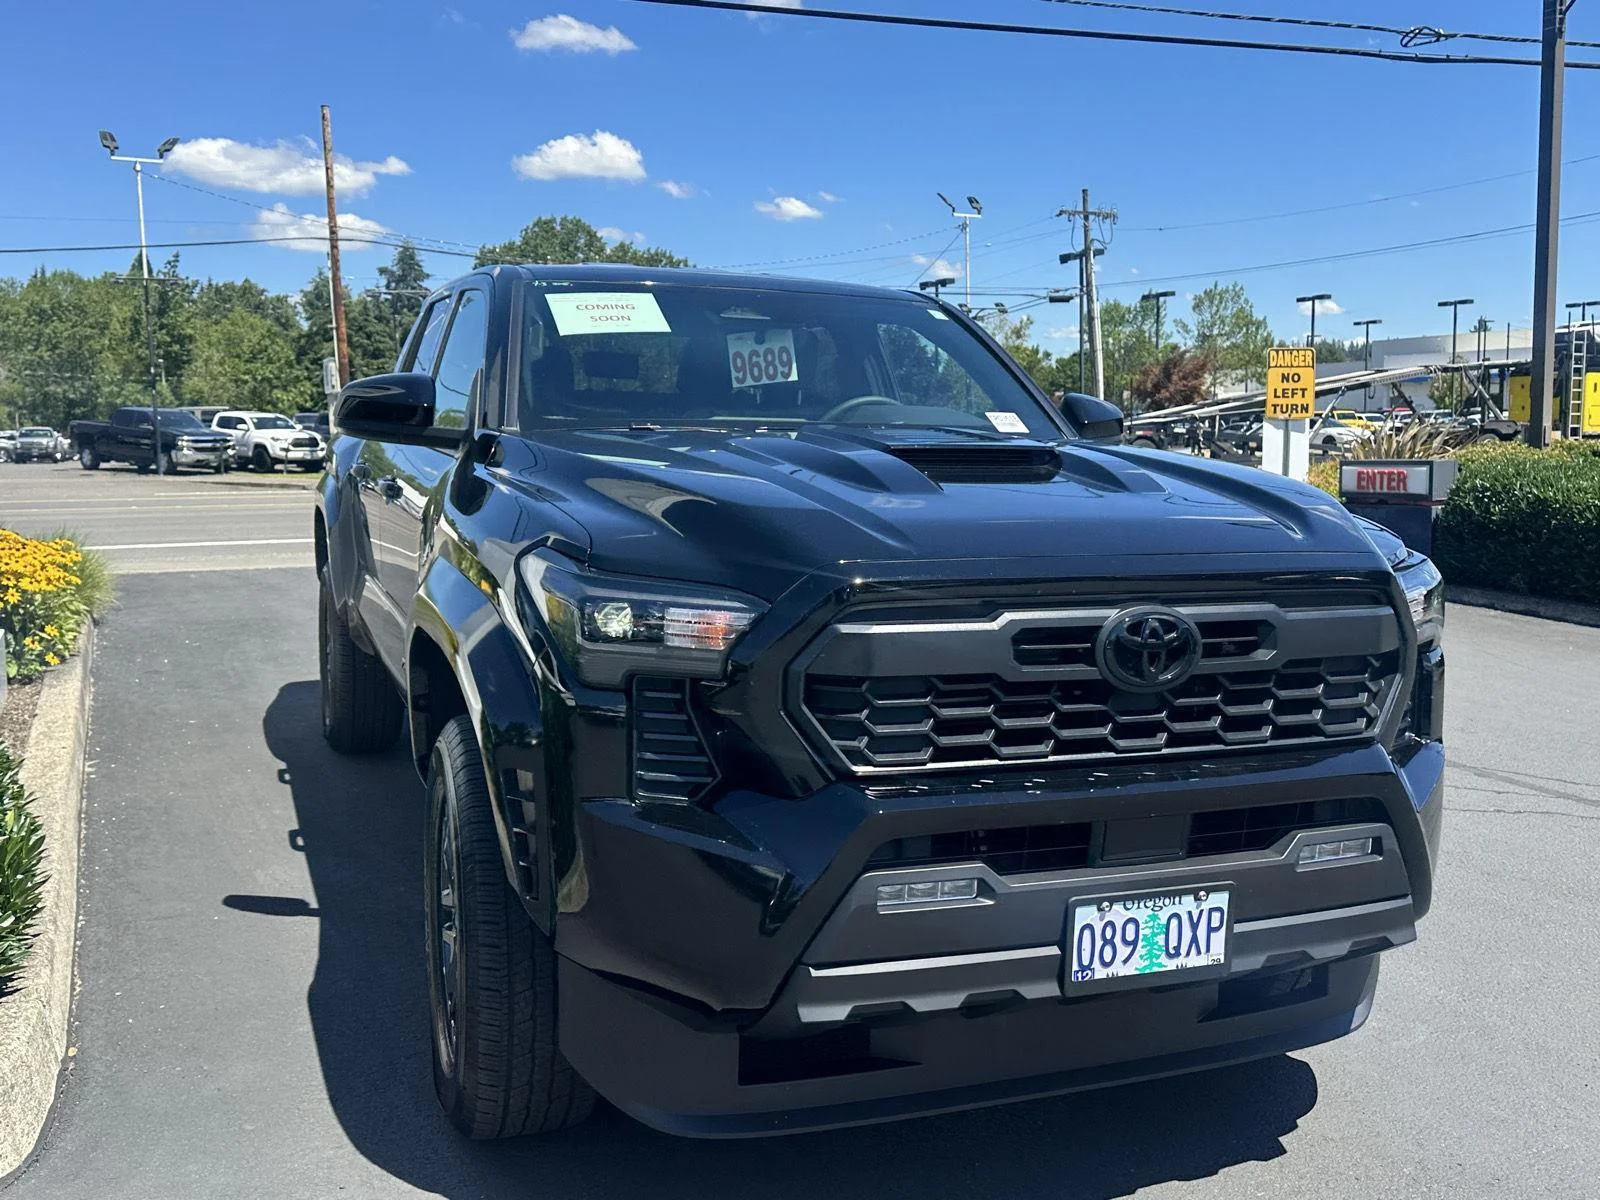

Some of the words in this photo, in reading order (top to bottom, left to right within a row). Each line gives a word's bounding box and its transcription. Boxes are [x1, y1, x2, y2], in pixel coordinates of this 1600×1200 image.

[576, 303, 636, 311] COMING
[732, 345, 793, 385] 9689
[1269, 350, 1313, 367] DANGER
[1281, 373, 1300, 383] NO
[1273, 388, 1308, 399] LEFT
[1271, 403, 1310, 414] TURN
[1356, 470, 1408, 492] ENTER
[1123, 896, 1183, 912] Oregon
[1077, 917, 1140, 970] 089
[1164, 906, 1225, 959] QXP
[1076, 969, 1092, 981] 12
